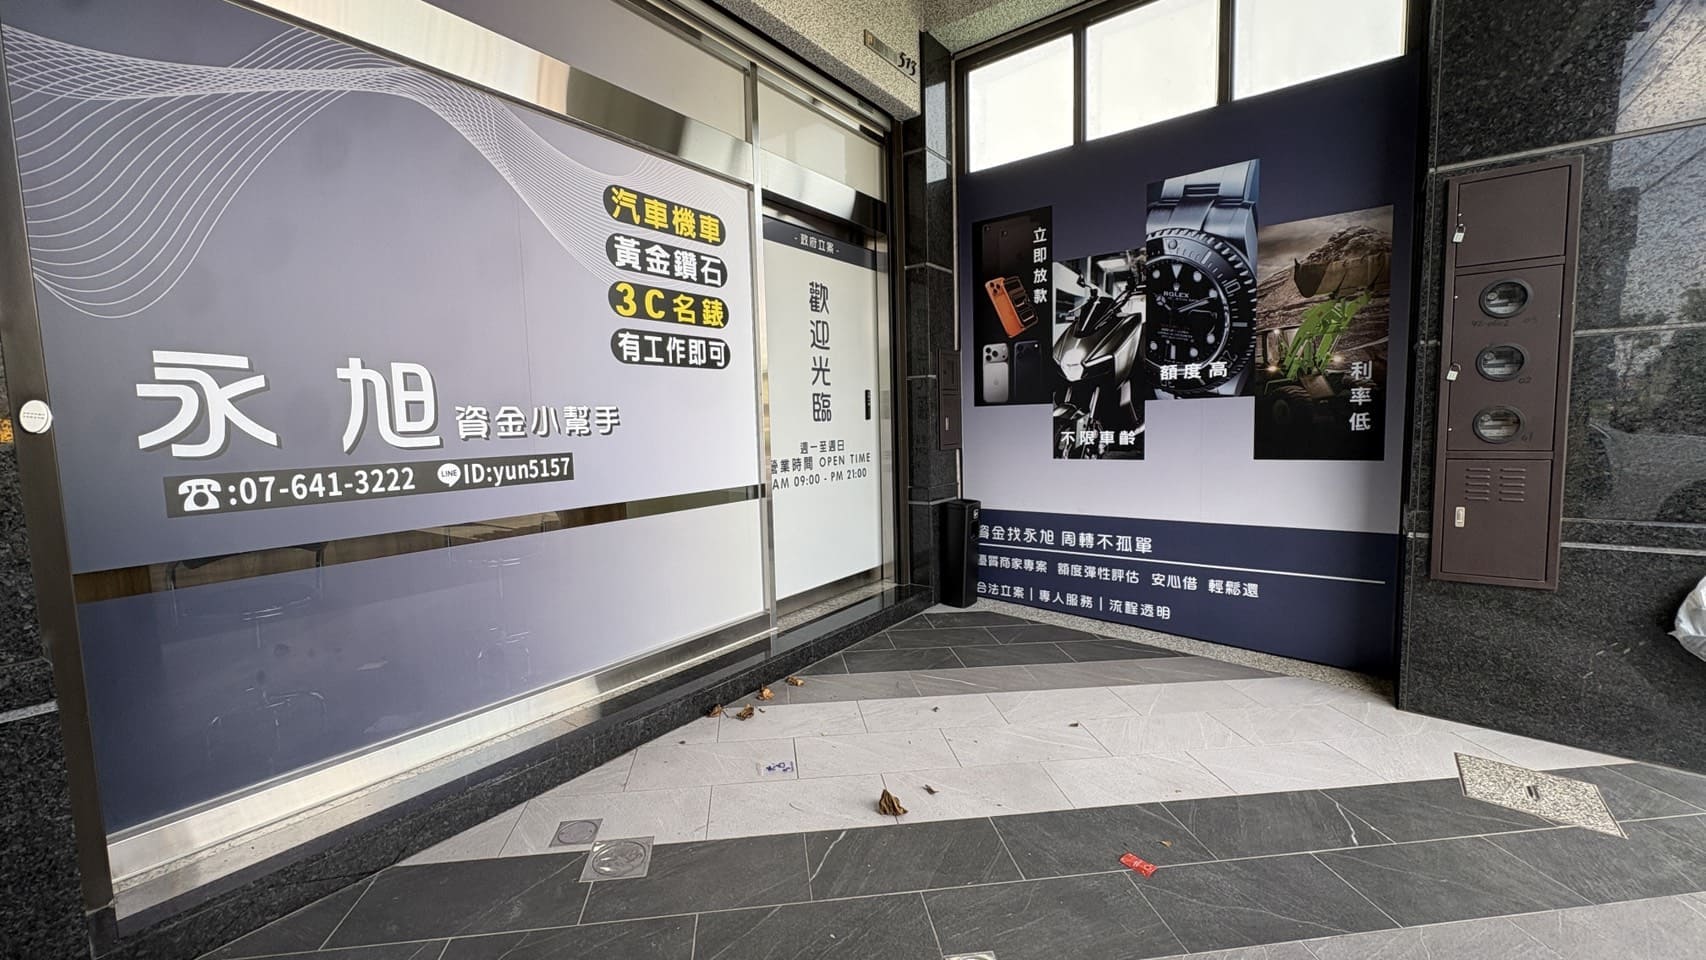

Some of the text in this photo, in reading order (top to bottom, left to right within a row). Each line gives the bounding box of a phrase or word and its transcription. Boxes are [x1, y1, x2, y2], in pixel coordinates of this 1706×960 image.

[898, 51, 917, 76] 513
[611, 186, 721, 243] 汽車機車
[613, 235, 722, 287] 黃金鑽石
[1033, 226, 1047, 304] 立即放款
[618, 331, 726, 367] 有工作即可
[809, 281, 832, 423] 歡迎光臨
[1159, 361, 1229, 381] 額度高
[1348, 360, 1373, 431] 利率低
[455, 405, 620, 439] 資金小幫手
[1060, 430, 1136, 446] 不限車齡
[800, 439, 845, 454] 週一至週日
[819, 455, 845, 468] OPEN
[850, 452, 871, 464] TIME
[440, 469, 457, 479] LINE
[463, 457, 571, 487] ID:yun5157
[772, 477, 790, 490] AM
[794, 474, 820, 487] 09:00
[830, 470, 843, 482] PM
[847, 468, 867, 480] 21:00
[978, 524, 1153, 554] 資金找永旭 周轉不孤單
[1057, 562, 1140, 584] 額度彈性評估
[1151, 573, 1198, 591] 安心借
[1208, 579, 1259, 598] 輕鬆還
[977, 581, 1171, 620] 合法立案 專人服務 流程透明
